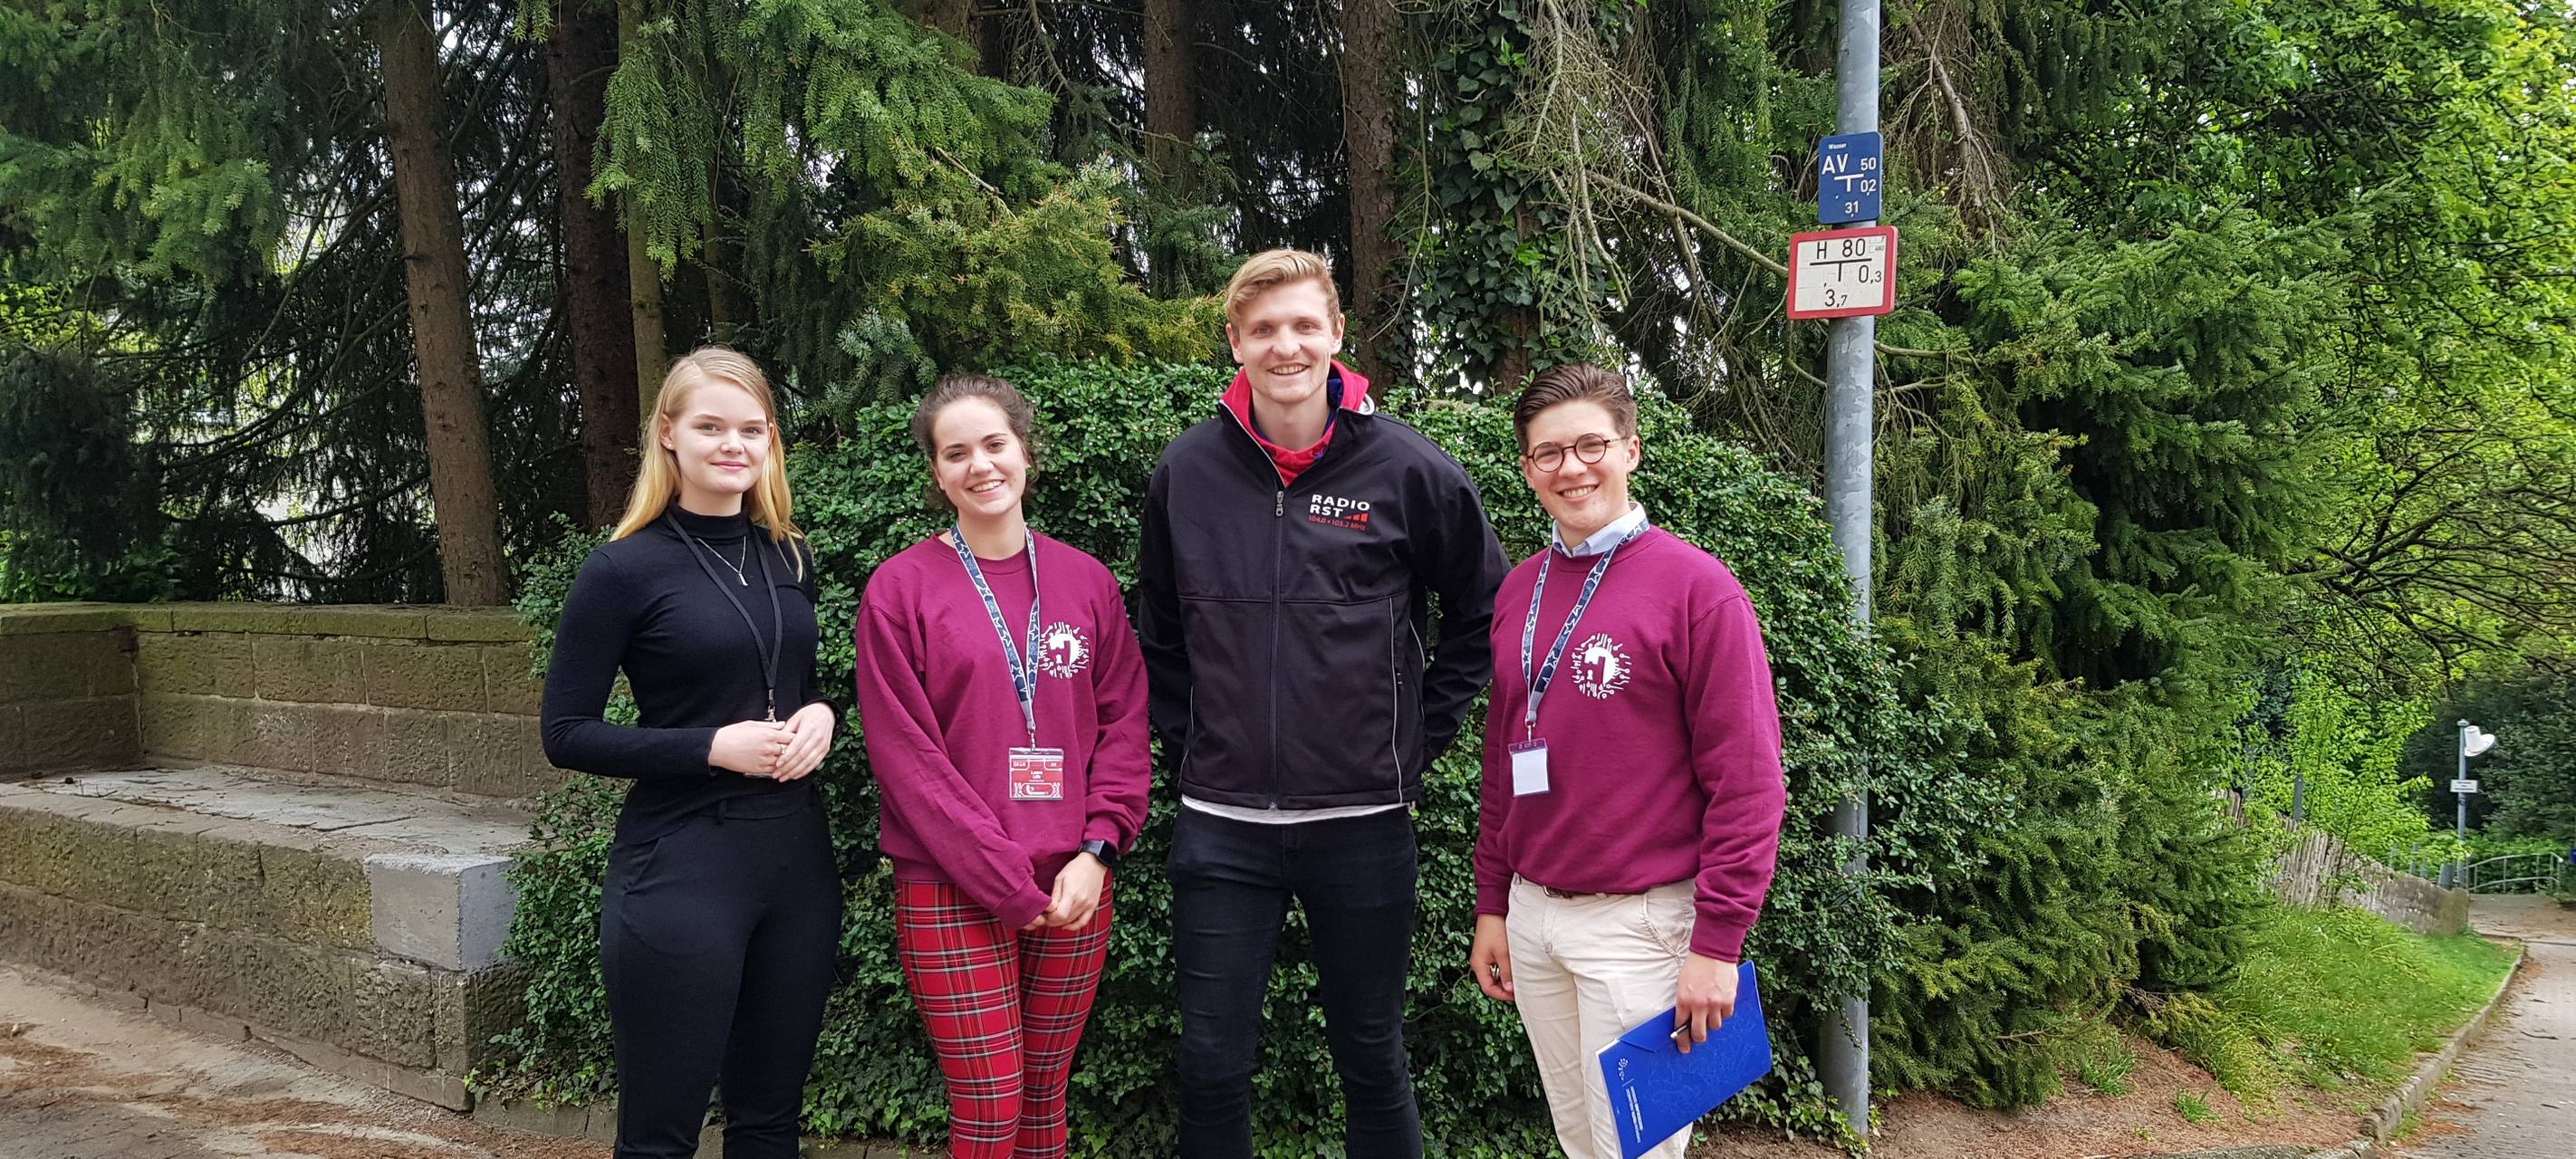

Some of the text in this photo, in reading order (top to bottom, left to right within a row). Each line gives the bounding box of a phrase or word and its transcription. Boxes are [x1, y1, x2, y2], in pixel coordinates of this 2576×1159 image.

[1821, 153, 1877, 175] AV 50
[1816, 238, 1866, 259] H 80
[1859, 264, 1882, 284] 0,3
[1824, 289, 1848, 308] 3,7
[1310, 504, 1343, 517] RST
[1312, 494, 1370, 511] RADIO
